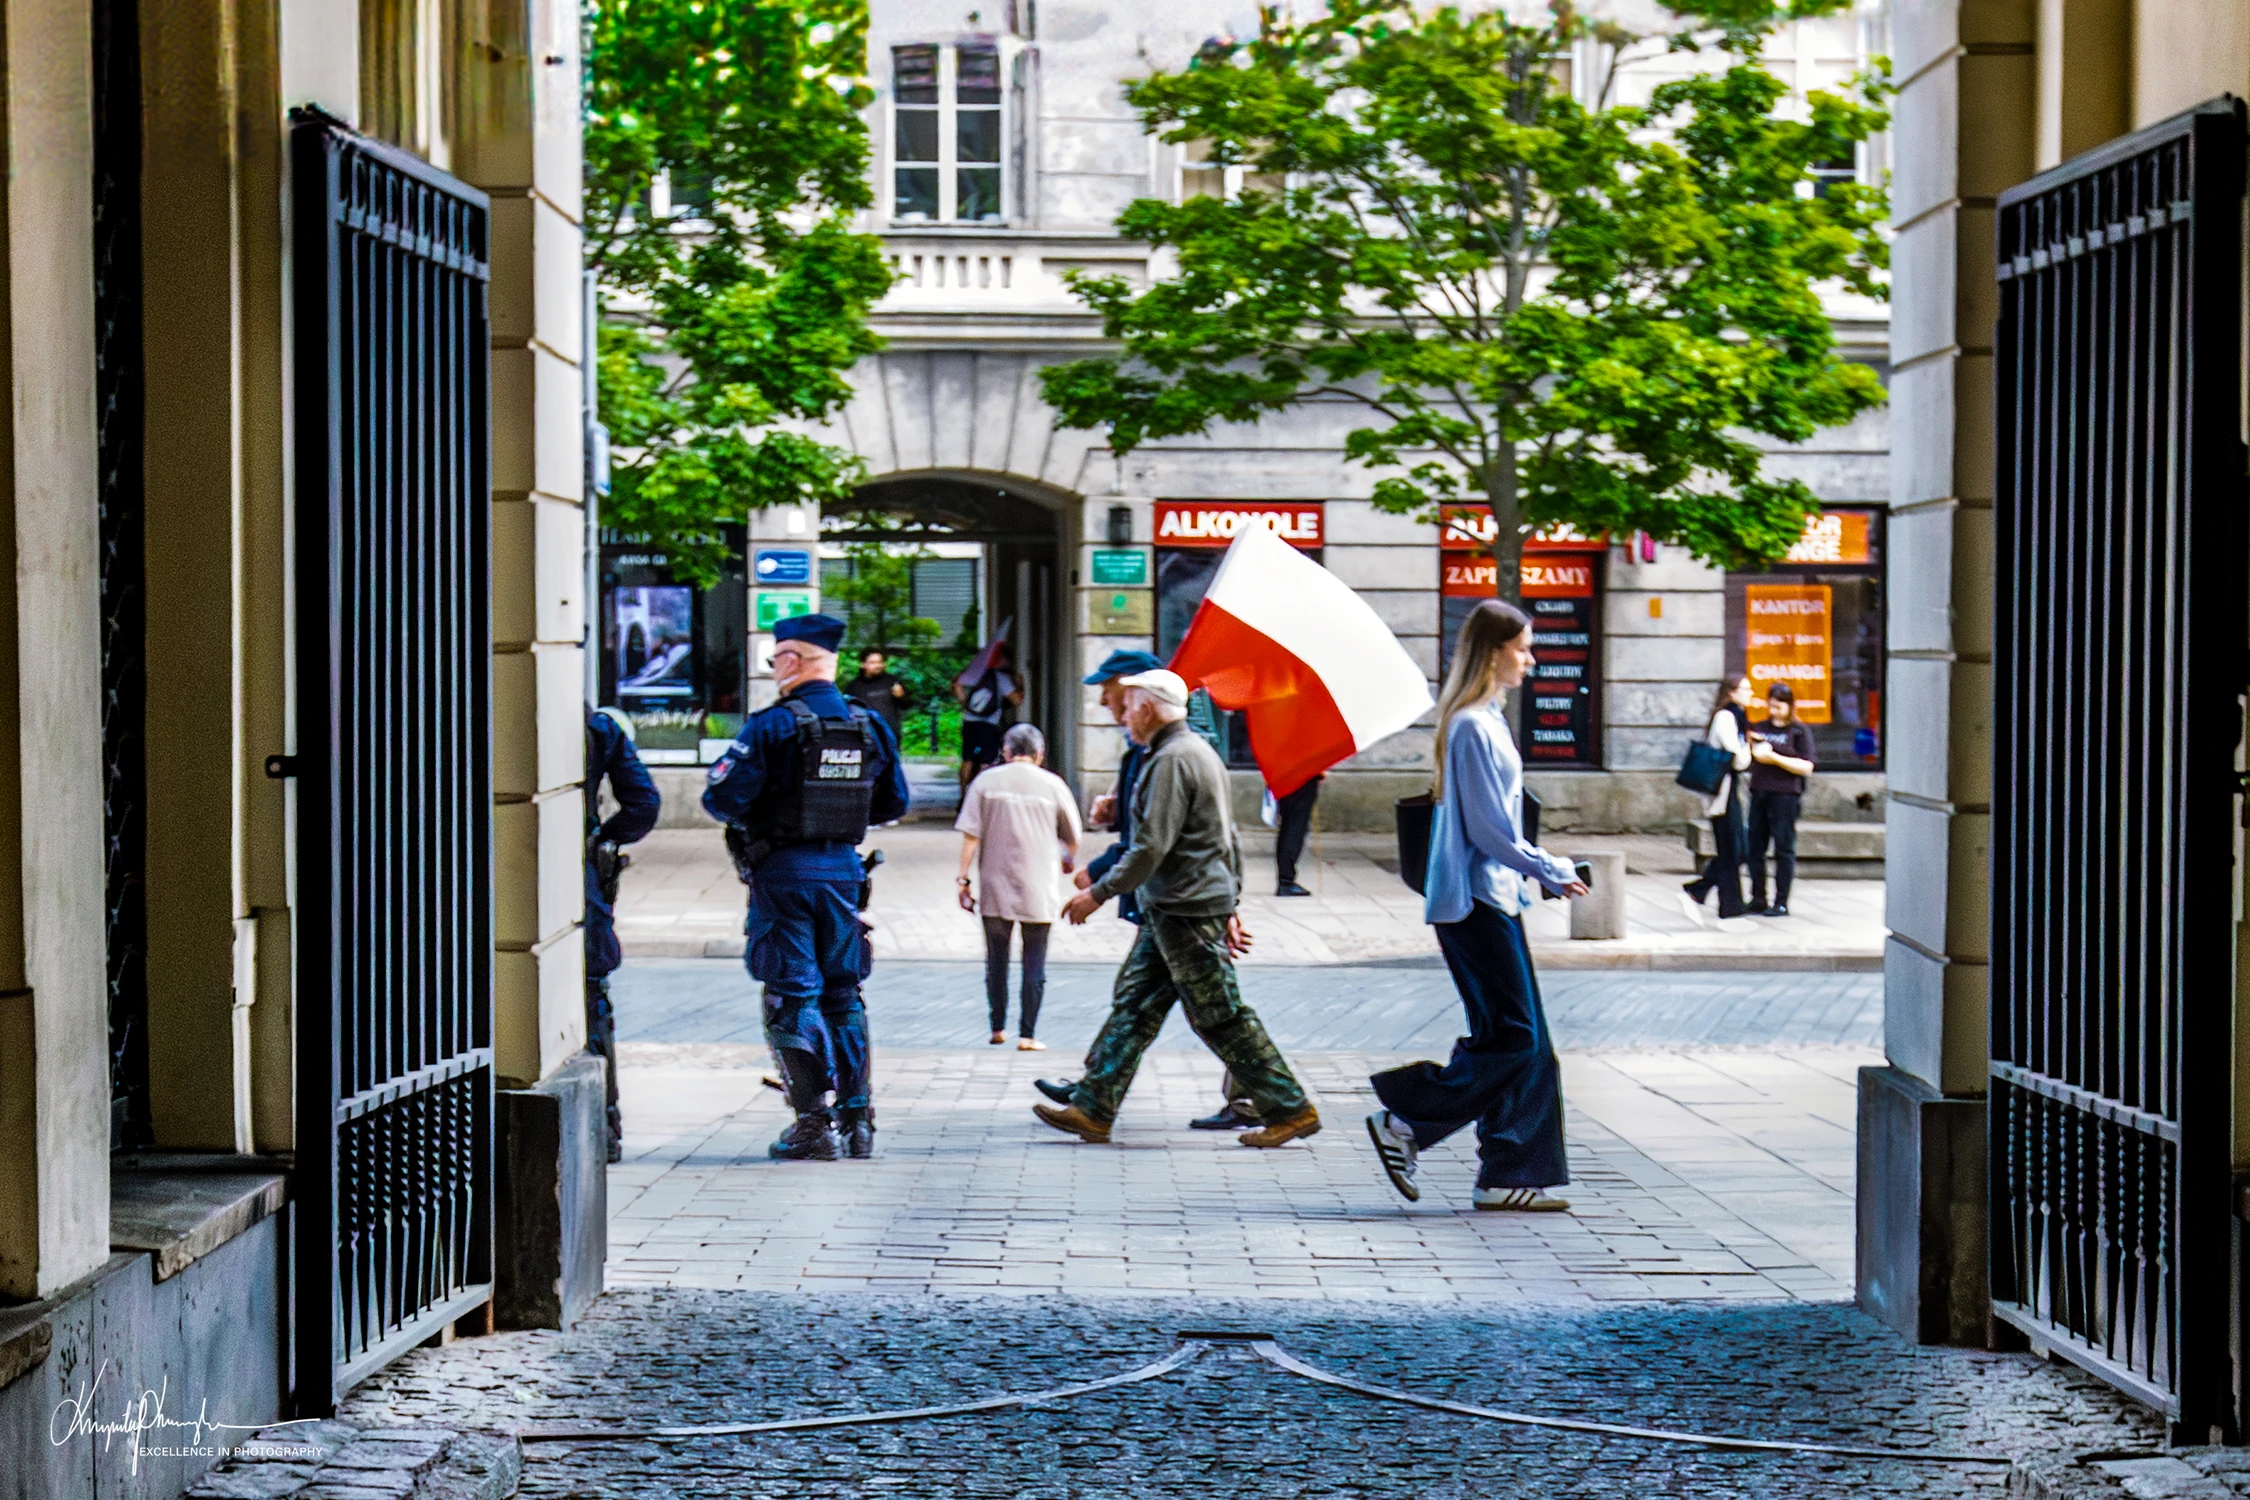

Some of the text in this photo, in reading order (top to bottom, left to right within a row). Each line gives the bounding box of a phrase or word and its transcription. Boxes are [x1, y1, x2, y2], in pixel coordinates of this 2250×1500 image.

[1446, 566, 1590, 585] ZAPSZAMY
[1751, 600, 1825, 615] KANTOR
[1751, 664, 1826, 680] CHANGE
